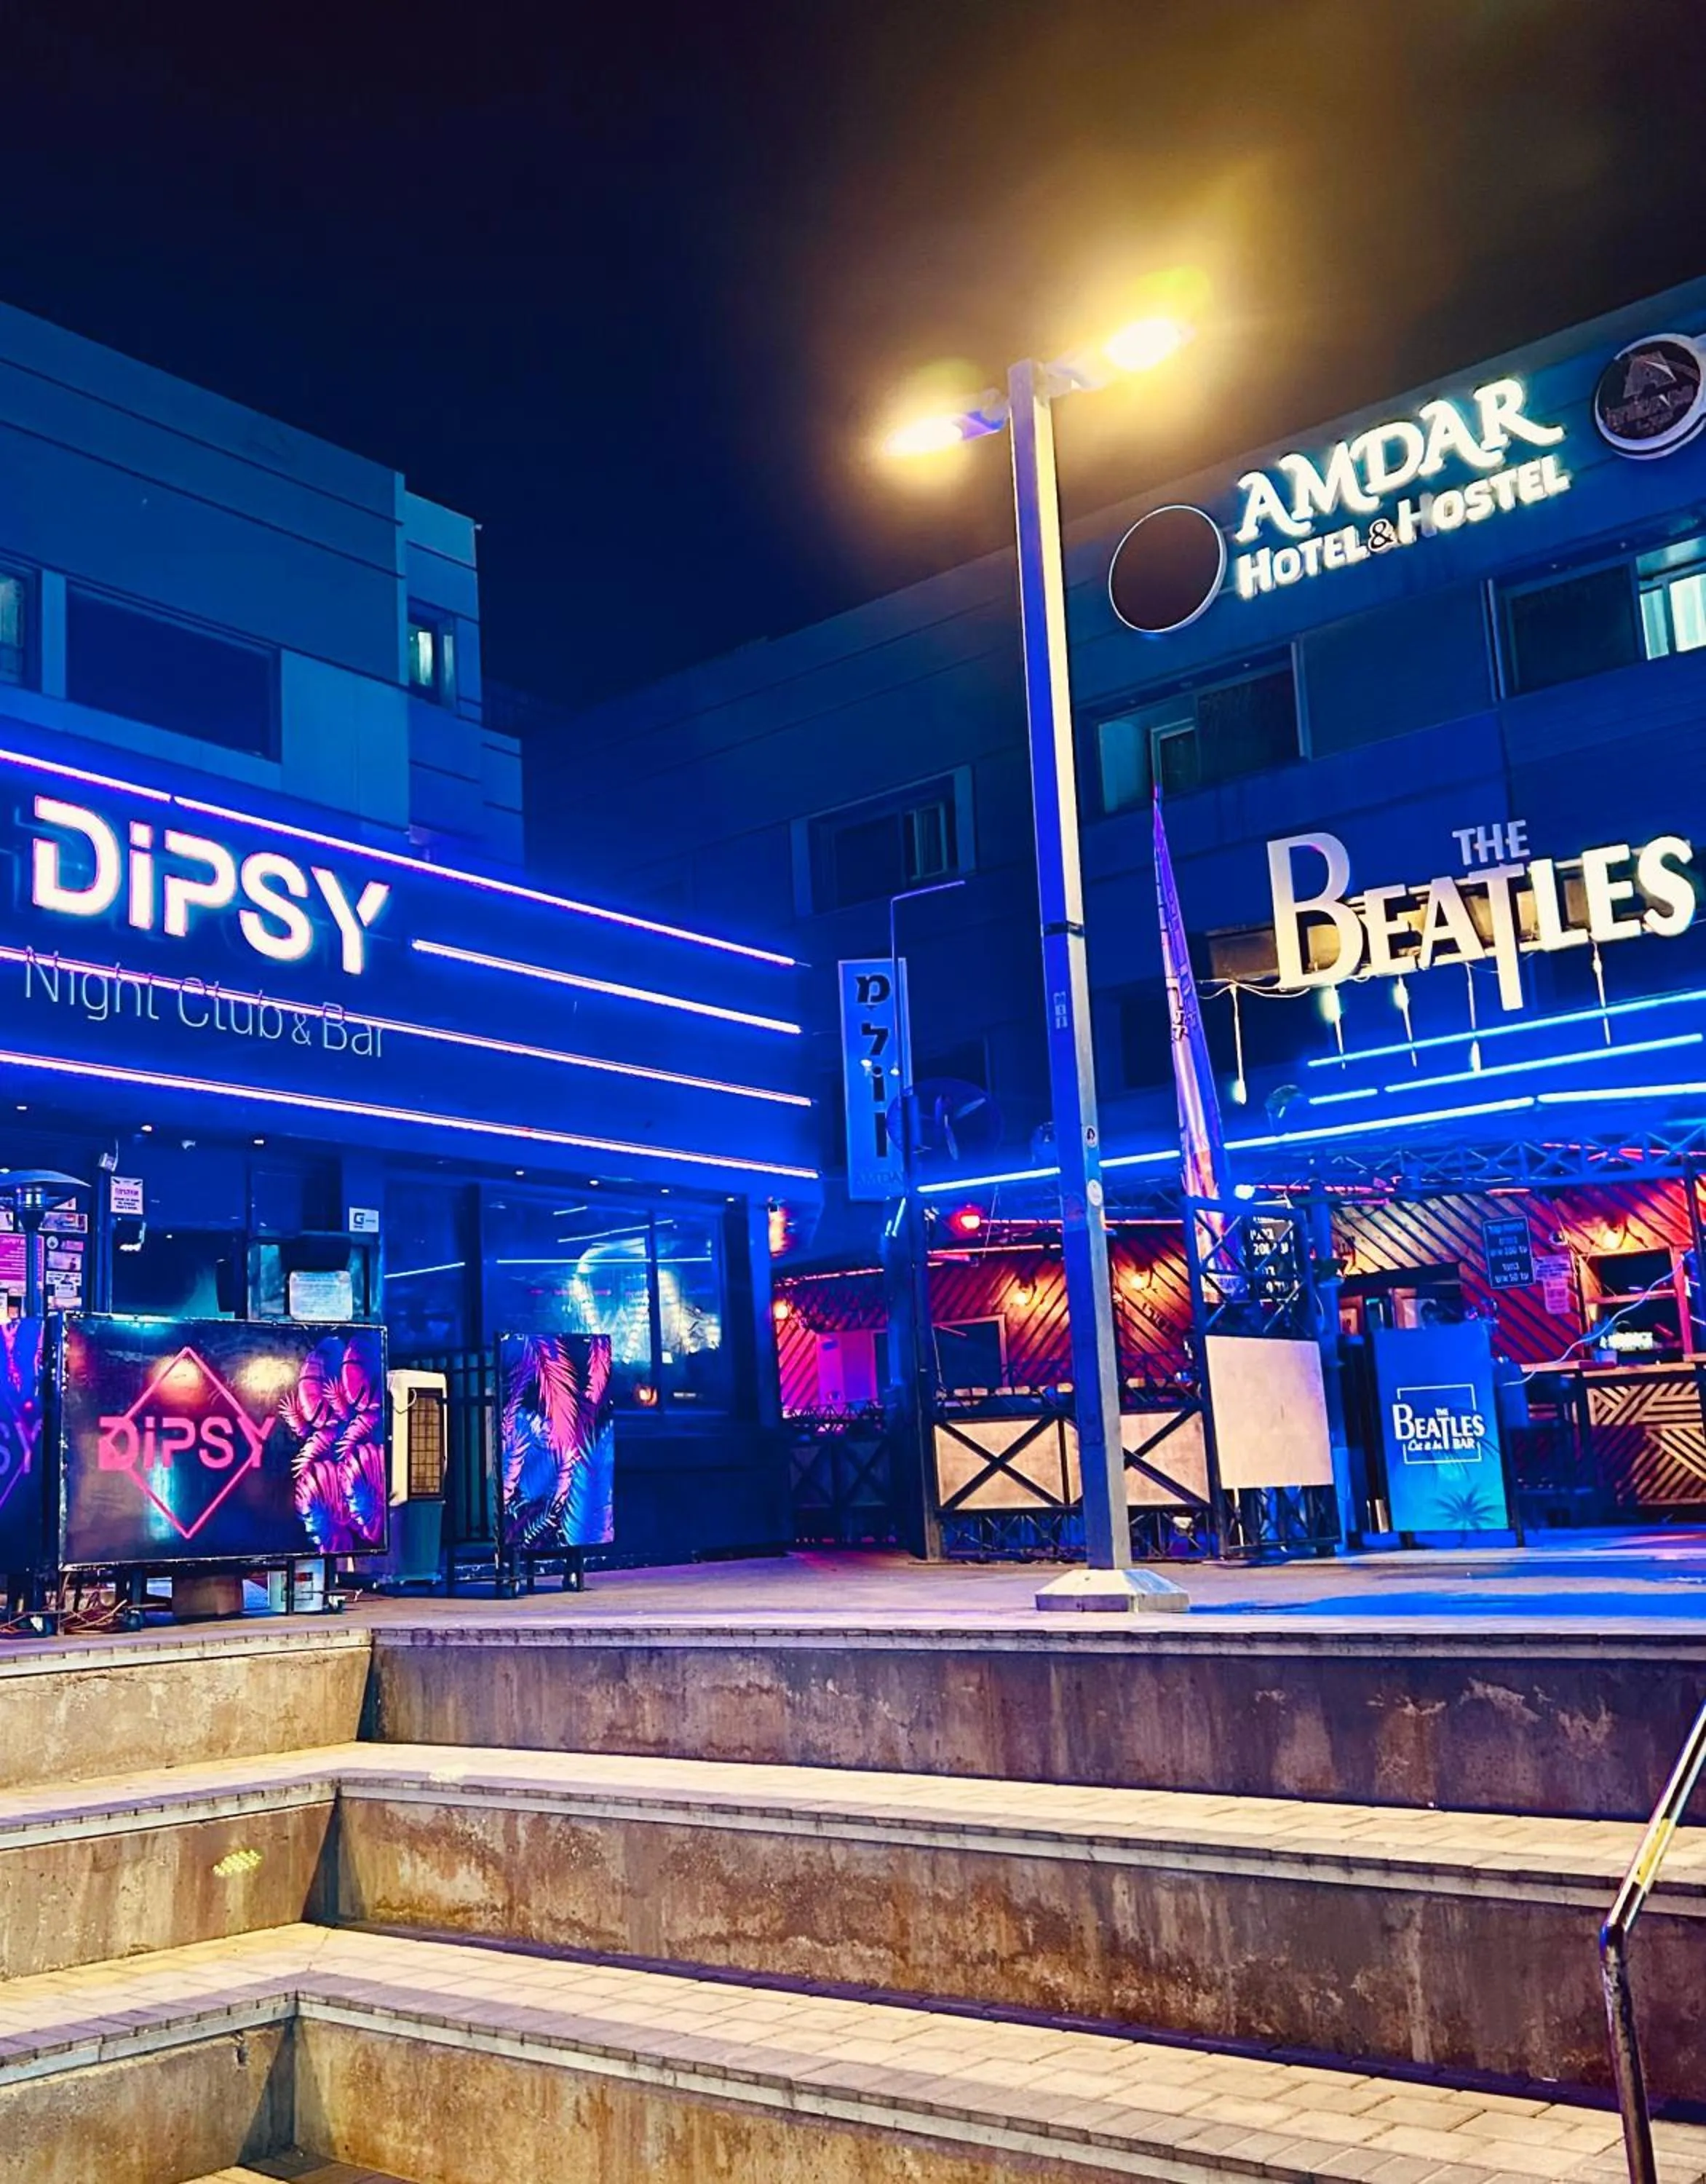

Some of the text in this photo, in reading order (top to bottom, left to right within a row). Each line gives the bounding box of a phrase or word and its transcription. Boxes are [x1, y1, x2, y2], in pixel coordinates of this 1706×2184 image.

[1235, 378, 1565, 542] AMDAR
[1236, 525, 1371, 601] HOTEL
[1397, 455, 1571, 546] HOSTEL
[1452, 819, 1530, 866] THE
[1266, 831, 1696, 1011] BEATLES
[25, 945, 384, 1058] Night Club & Bar
[1392, 1404, 1485, 1450] BEATLES
[1453, 1438, 1475, 1449] BAR
